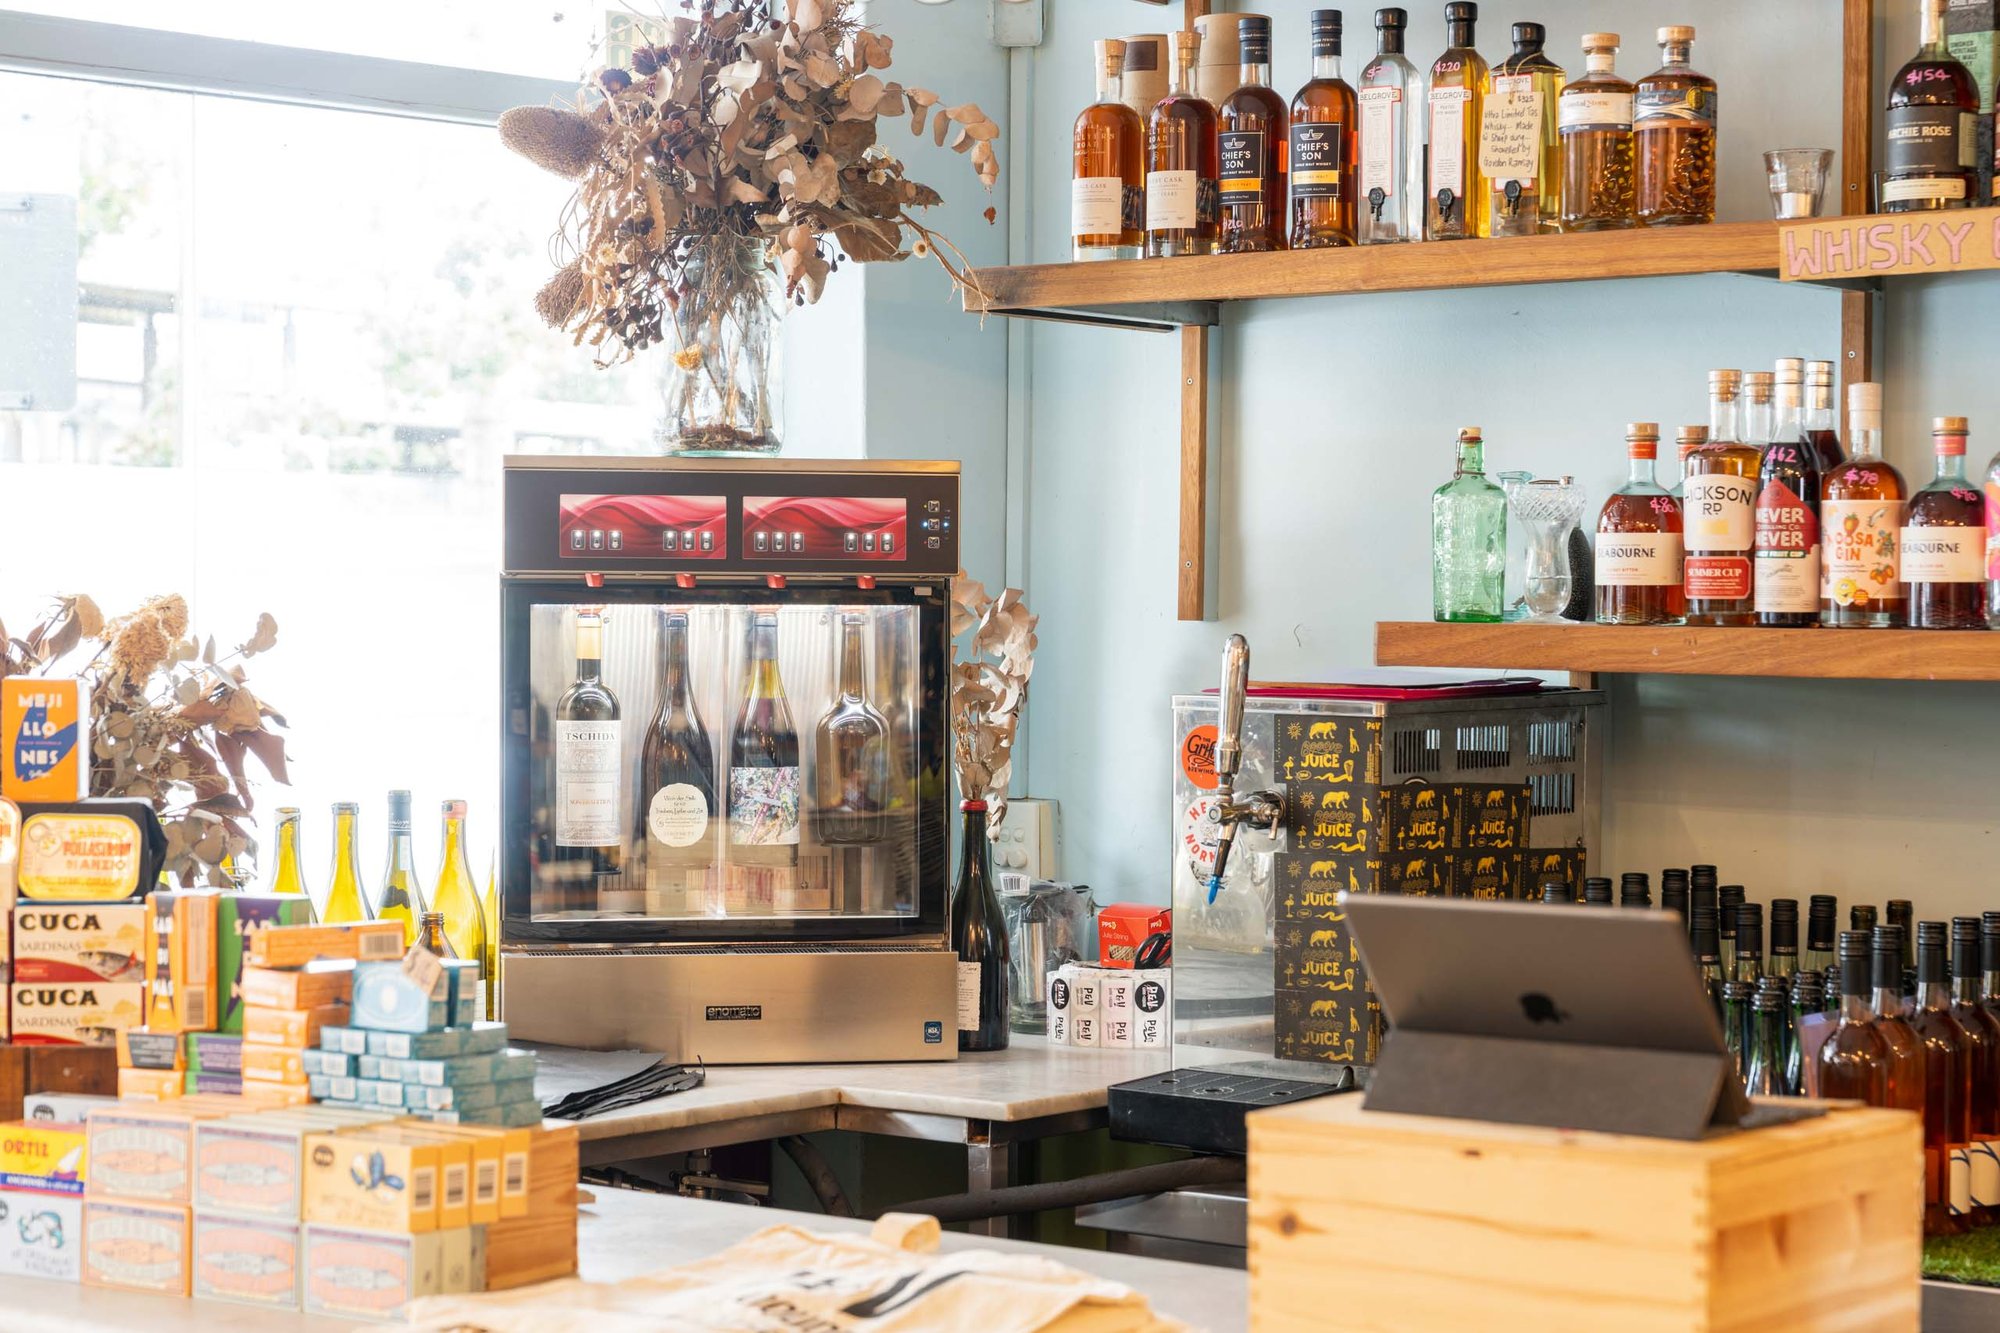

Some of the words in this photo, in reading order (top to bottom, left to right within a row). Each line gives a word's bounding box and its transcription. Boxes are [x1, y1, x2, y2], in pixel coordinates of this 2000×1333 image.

[1435, 61, 1460, 76] $220
[1906, 68, 1951, 86] $154
[1922, 126, 1952, 136] ROSE
[1296, 142, 1329, 152] CHIEF'S
[1221, 150, 1251, 160] CHIEF'S
[1301, 152, 1322, 161] SON
[1225, 160, 1244, 169] SON
[1786, 222, 1975, 277] WHISKY
[1767, 445, 1797, 463] $62
[1836, 546, 1860, 561] GIN
[1721, 568, 1742, 577] CUP
[22, 721, 57, 736] LLO
[566, 732, 615, 741] TSCHIDA
[21, 749, 58, 765] NES
[1300, 753, 1340, 768] JUICE
[1313, 822, 1353, 837] JUICE
[1409, 822, 1436, 837] JUICE
[1480, 820, 1505, 835] JUICE
[19, 913, 101, 931] CUCA
[1113, 933, 1129, 941] String
[20, 941, 82, 951] SARDINAS
[1301, 961, 1340, 976] JUICE
[17, 988, 98, 1006] CUCA
[1084, 987, 1094, 1006] P&V
[1115, 987, 1126, 1008] P&V
[17, 1017, 79, 1027] SARDINAS
[1147, 1019, 1157, 1038] P&V
[1081, 1019, 1092, 1041] P&V
[1116, 1021, 1127, 1040] P&V
[1301, 1031, 1341, 1047] JUICE
